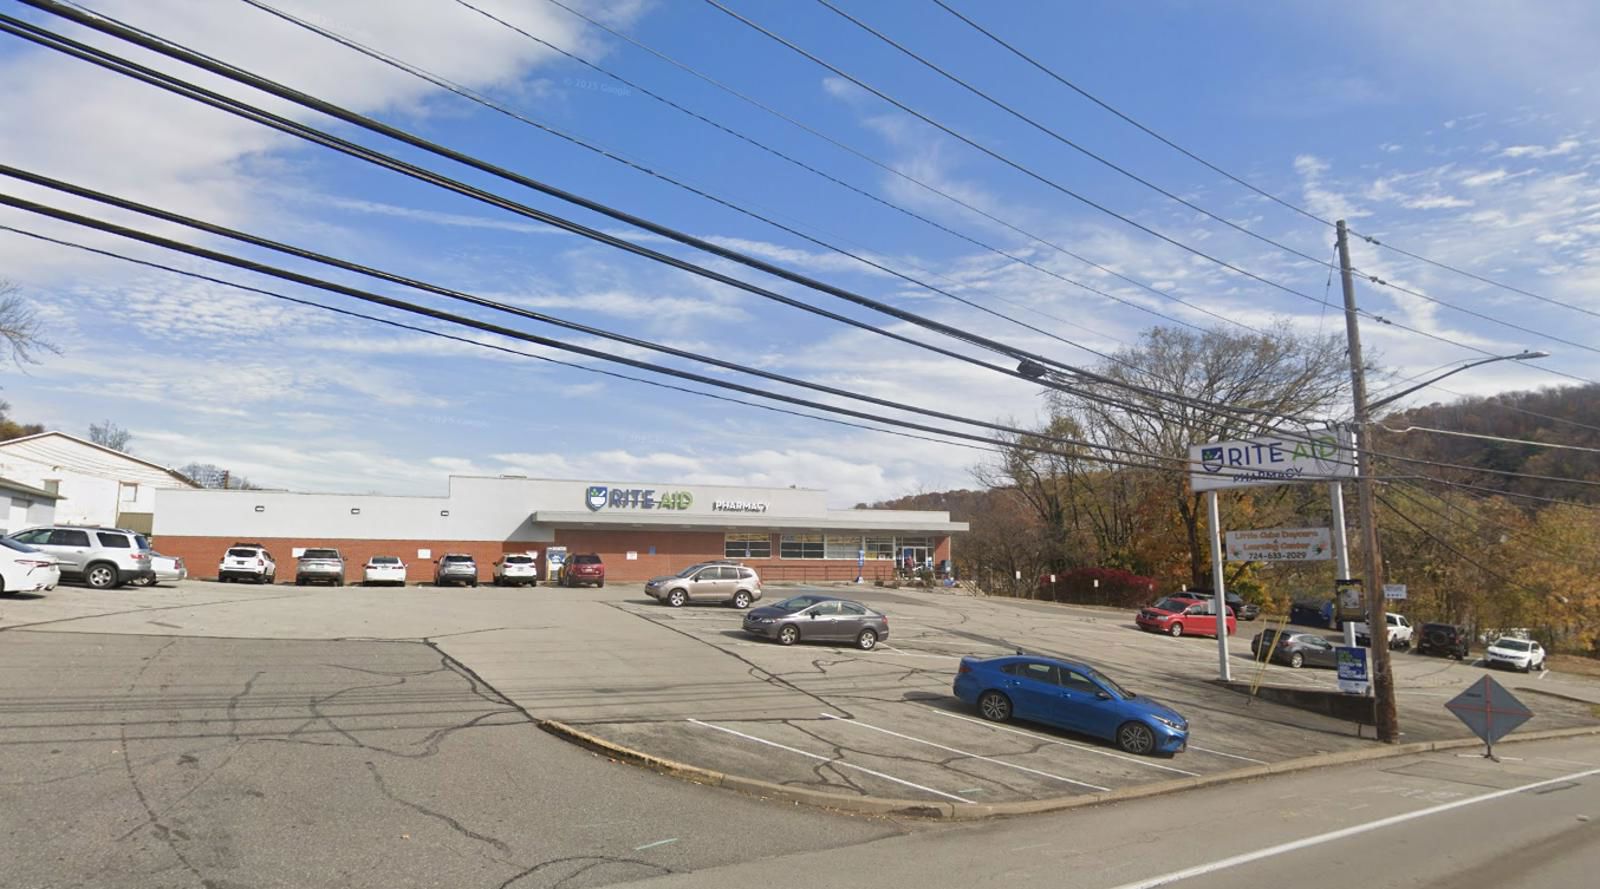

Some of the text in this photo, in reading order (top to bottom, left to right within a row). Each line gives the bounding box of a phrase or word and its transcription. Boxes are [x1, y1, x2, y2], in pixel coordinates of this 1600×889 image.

[1229, 437, 1337, 466] RITE AID
[1233, 467, 1303, 482] PHARMACY
[608, 488, 693, 509] RITE AID
[713, 501, 770, 512] PHARMACY
